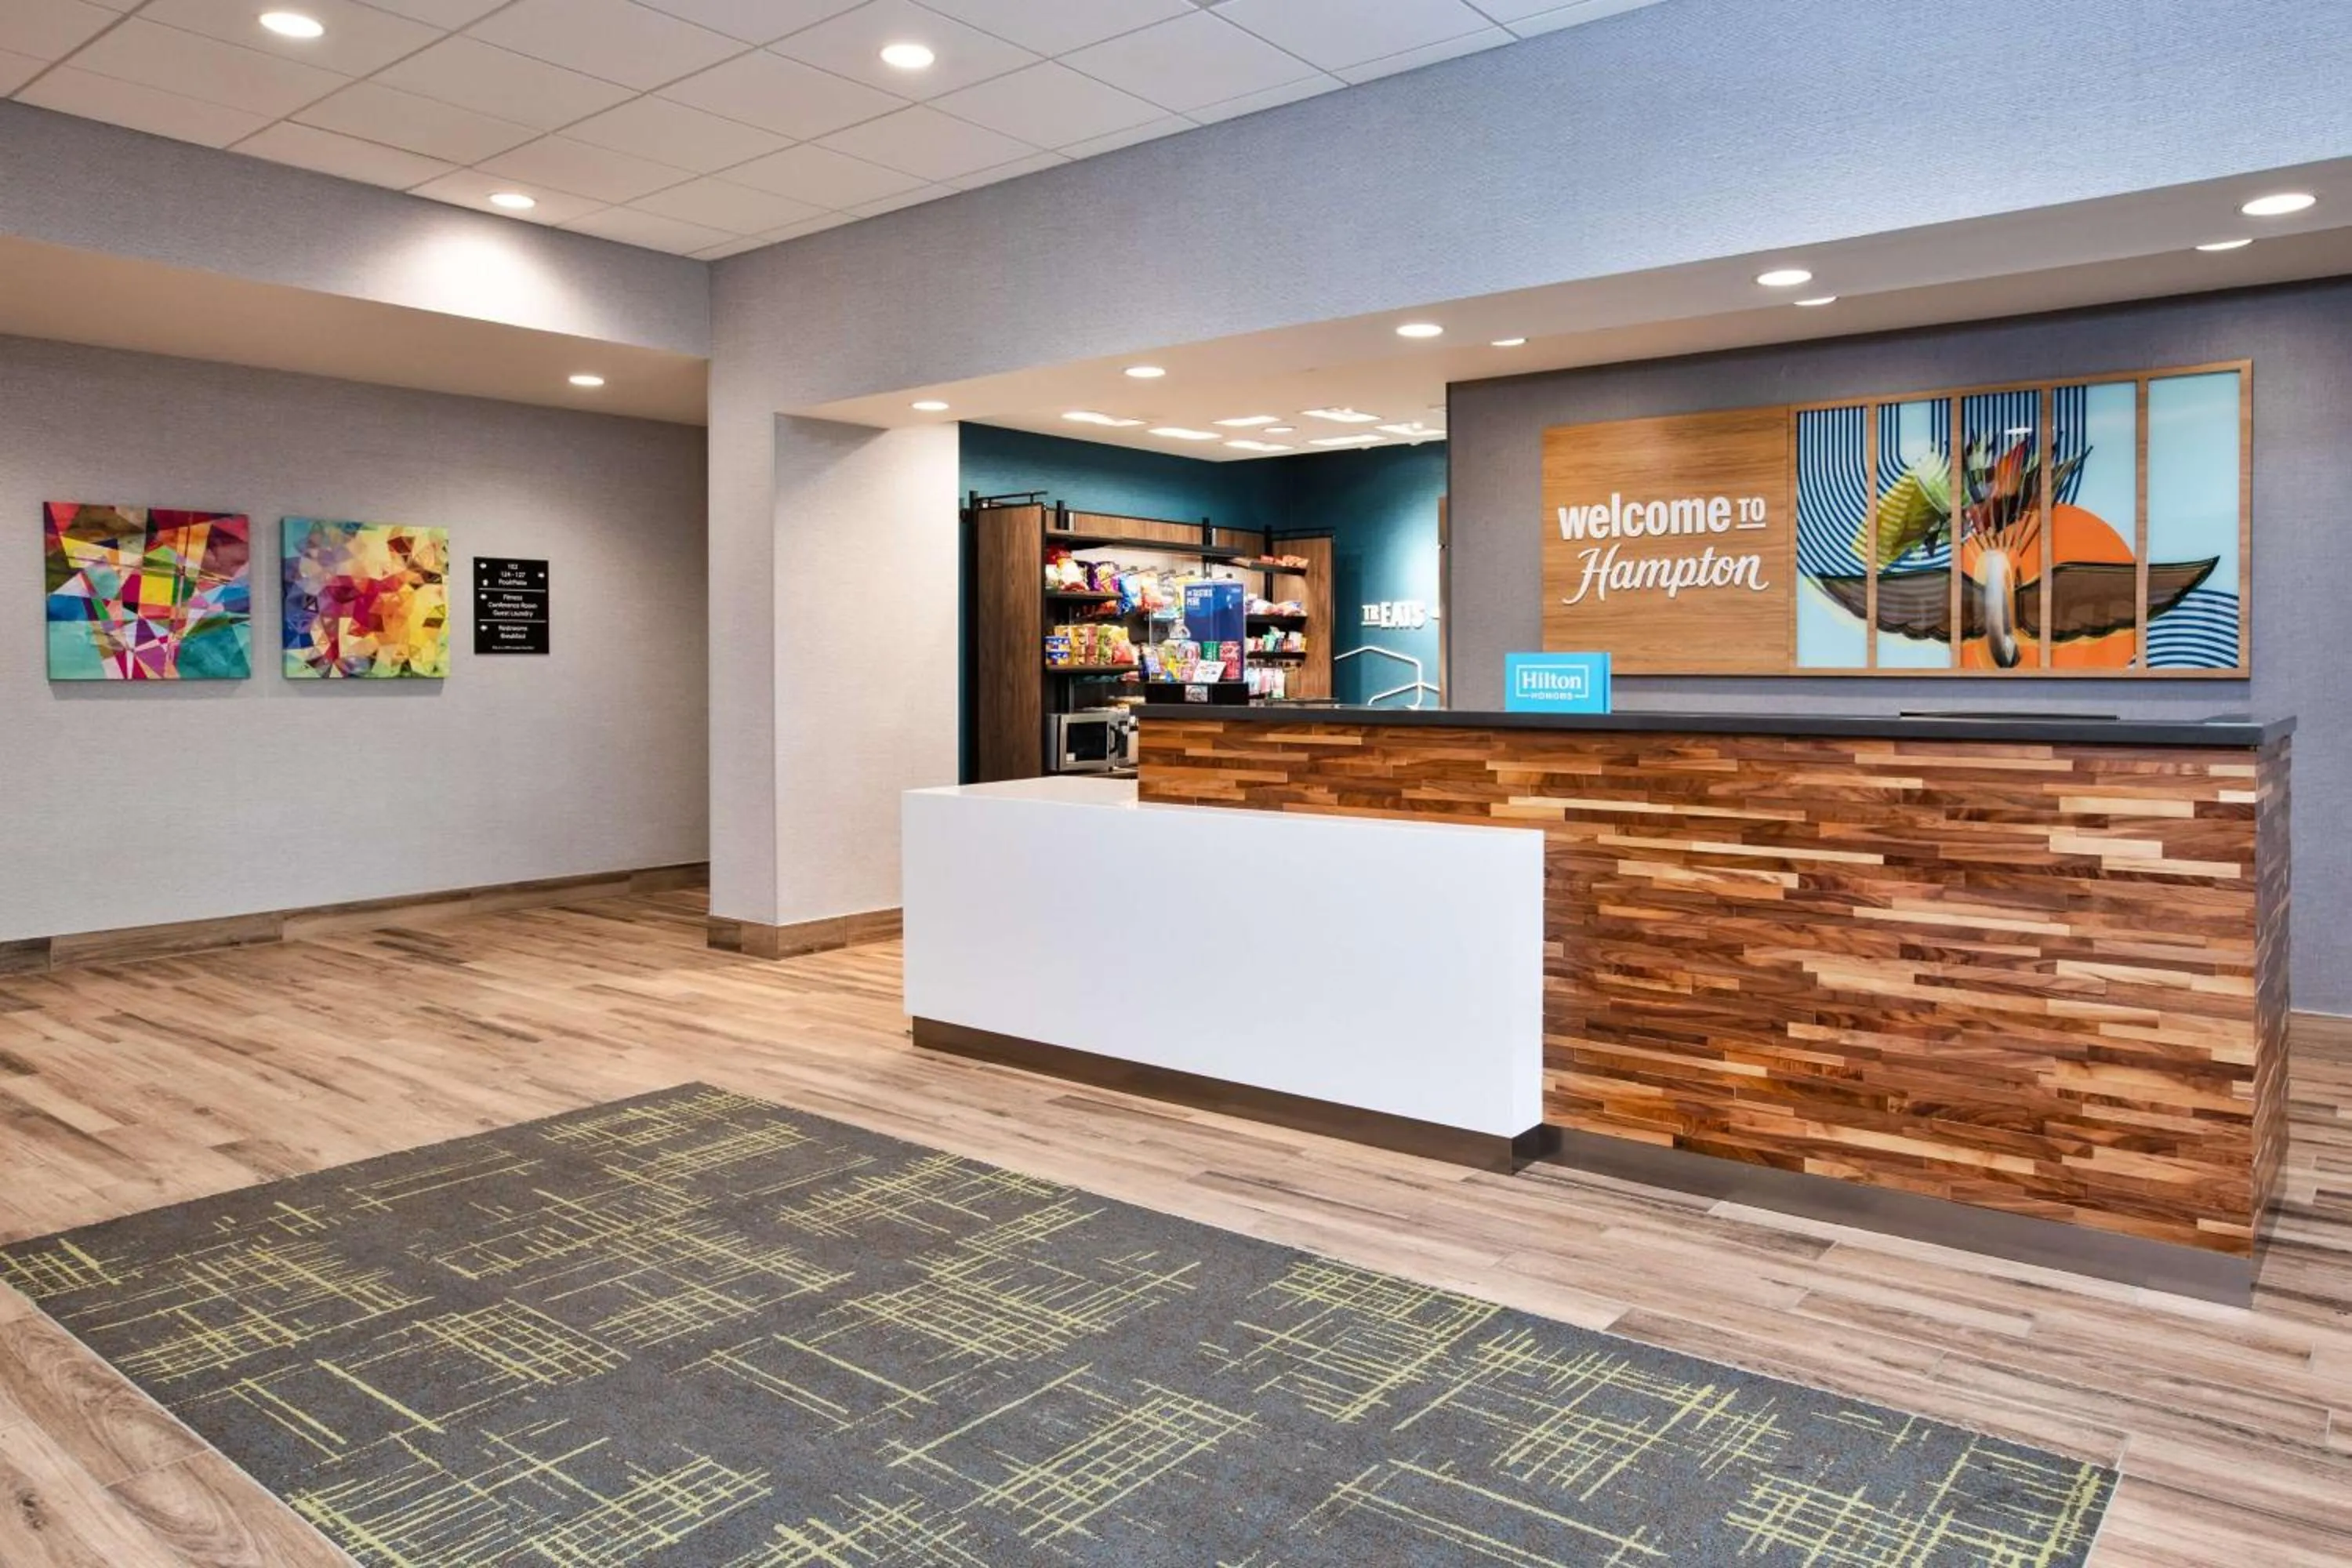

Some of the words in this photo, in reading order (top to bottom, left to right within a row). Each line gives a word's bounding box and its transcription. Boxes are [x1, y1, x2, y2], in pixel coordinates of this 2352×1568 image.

[1558, 492, 1731, 540] welcome
[1737, 497, 1766, 522] TO
[1562, 543, 1769, 604] Hampton
[1522, 670, 1582, 689] Hilton
[1530, 691, 1573, 700] HONORS
